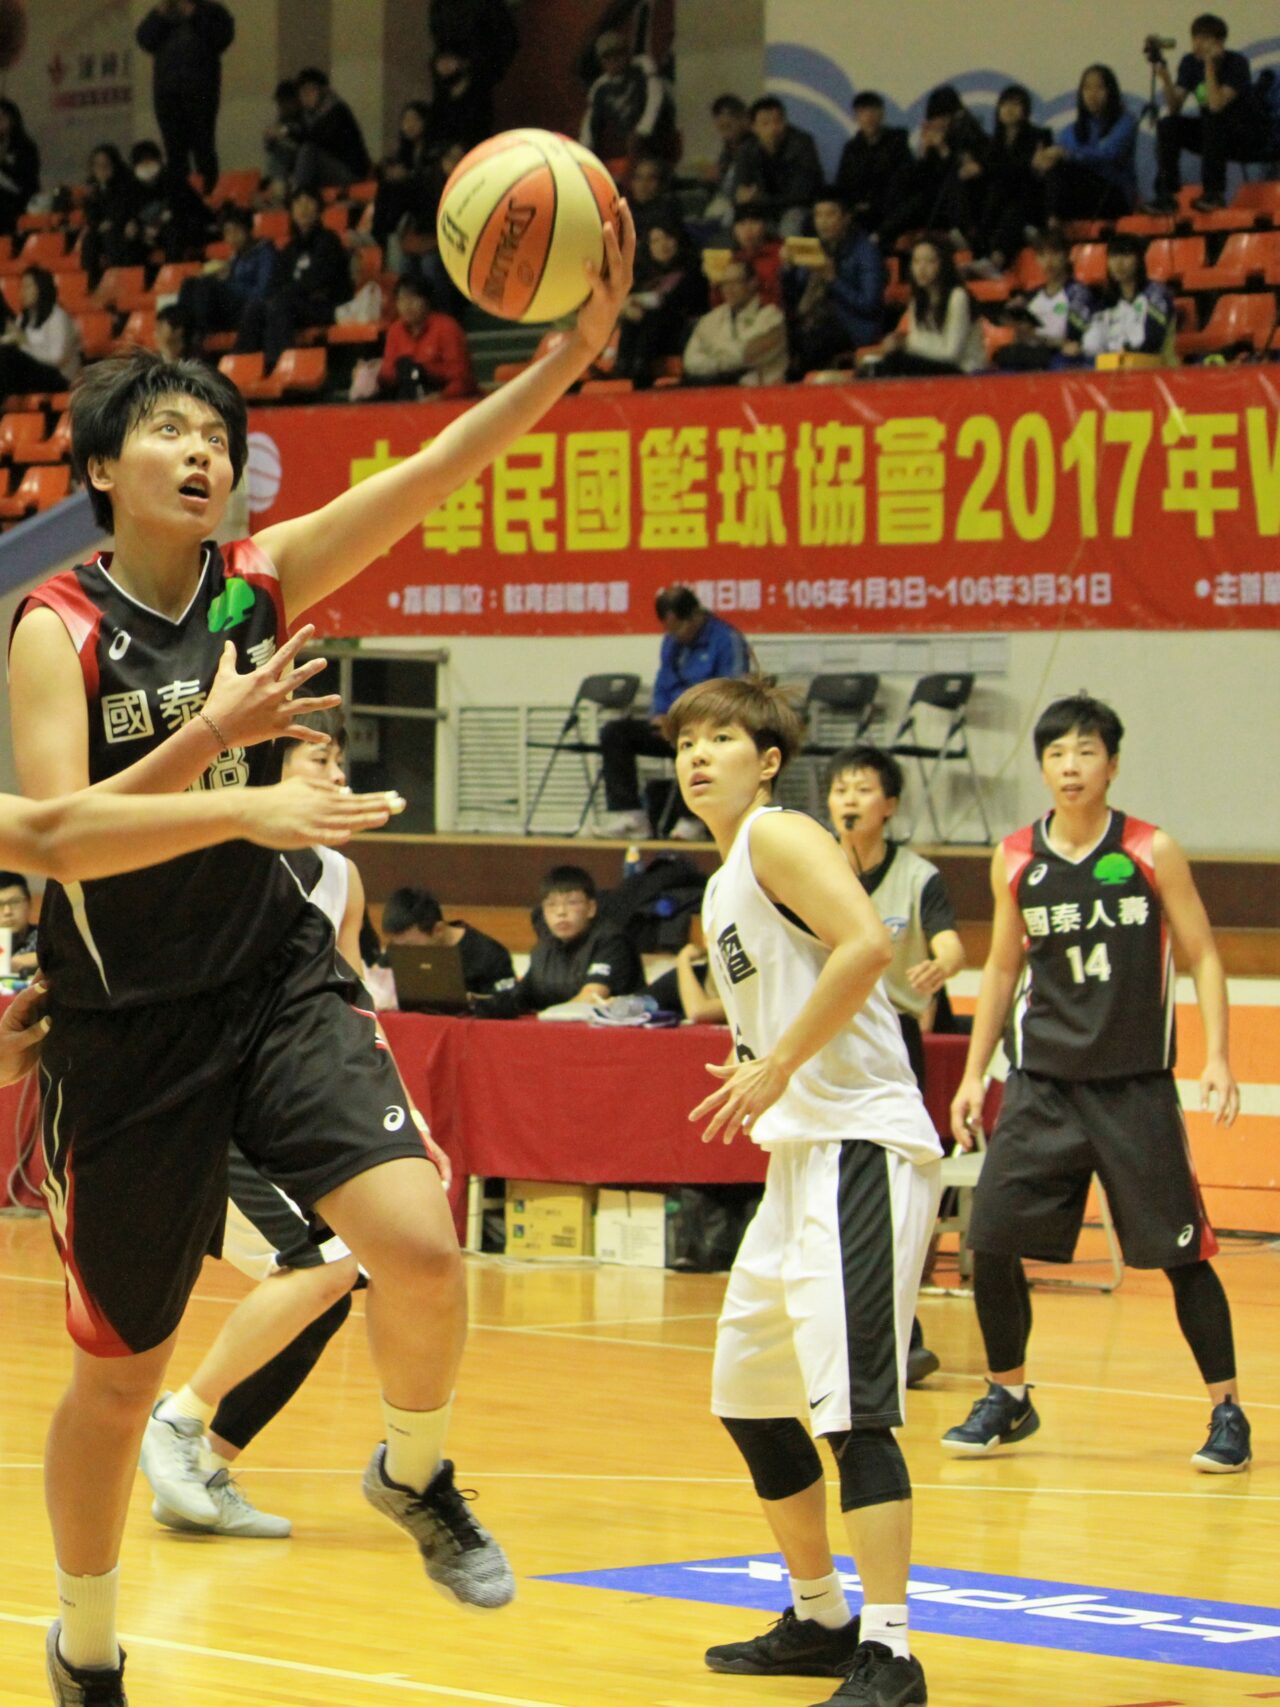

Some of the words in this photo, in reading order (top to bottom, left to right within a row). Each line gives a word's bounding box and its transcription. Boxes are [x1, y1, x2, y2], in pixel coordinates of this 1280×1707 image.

[671, 572, 1112, 612] 日期：106年1月3日~106年3月31日
[1022, 896, 1149, 937] 國泰人壽
[1066, 943, 1112, 984] 14
